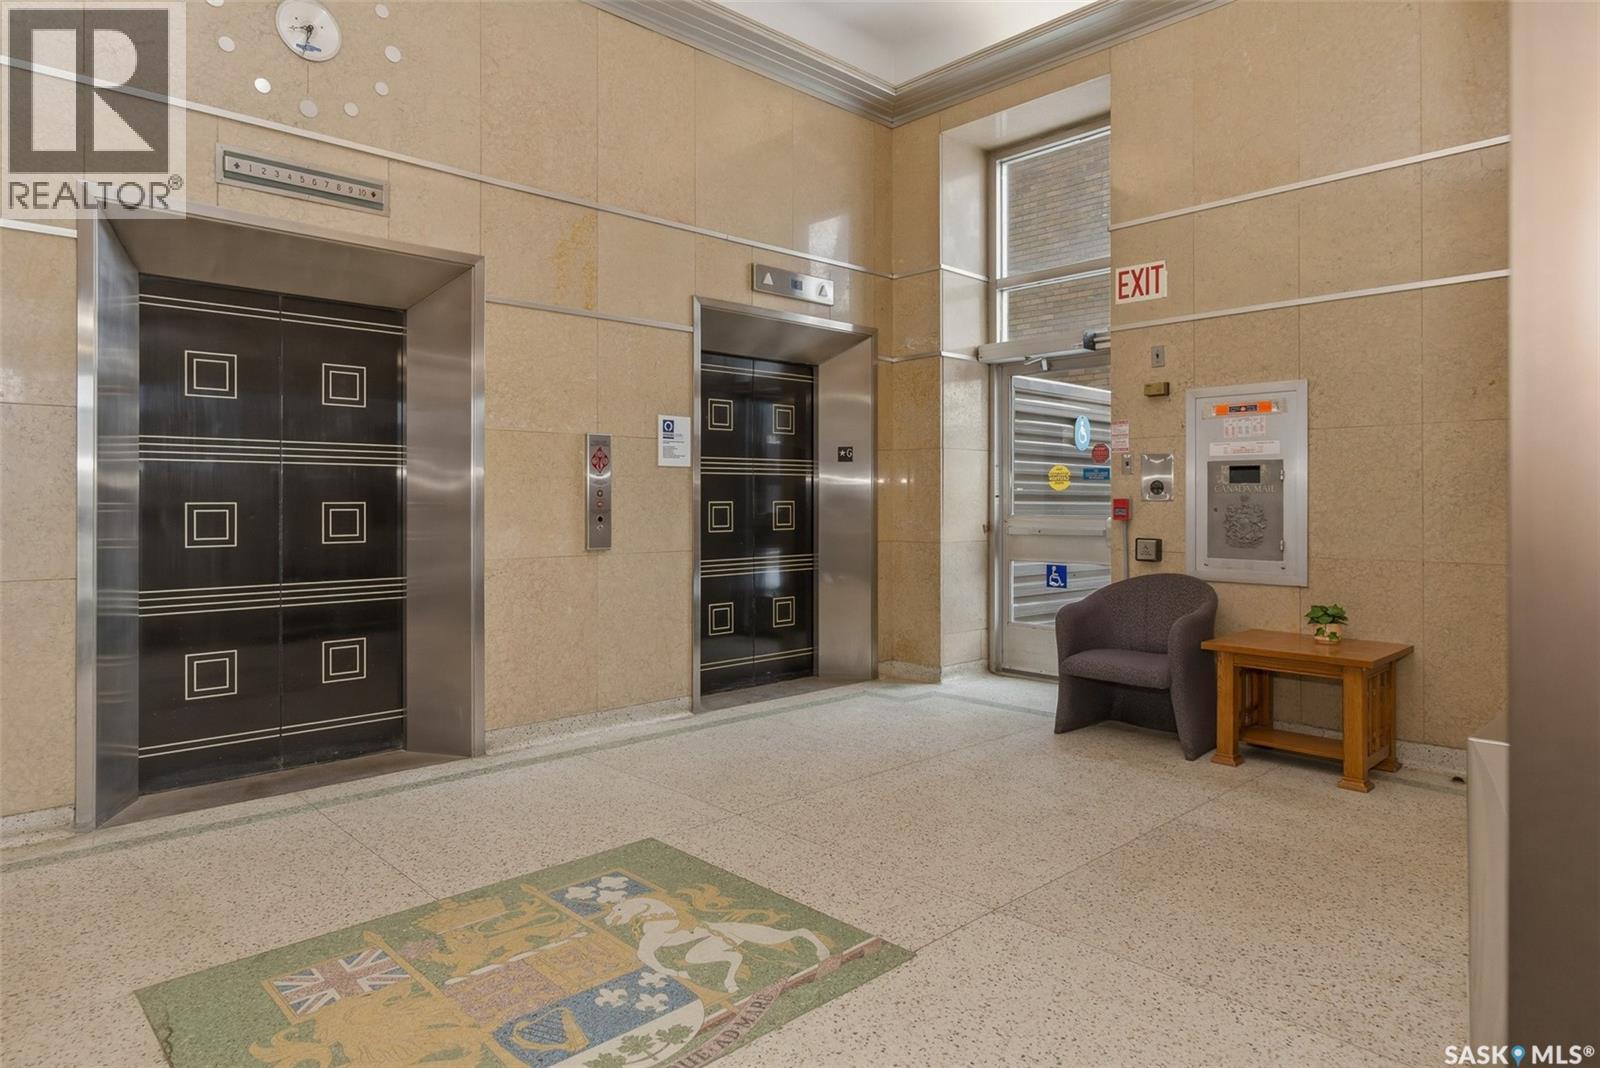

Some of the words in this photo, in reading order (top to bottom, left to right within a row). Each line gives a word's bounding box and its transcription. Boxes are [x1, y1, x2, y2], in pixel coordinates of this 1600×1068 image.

[261, 167, 267, 176] 2
[275, 170, 280, 178] 3
[287, 173, 292, 181] 4
[300, 175, 305, 184] 5
[312, 178, 317, 186] 6
[336, 183, 342, 192] 8
[348, 186, 354, 194] 9
[358, 188, 367, 197] 10
[1118, 263, 1164, 300] EXIT
[1254, 483, 1277, 493] MAIL
